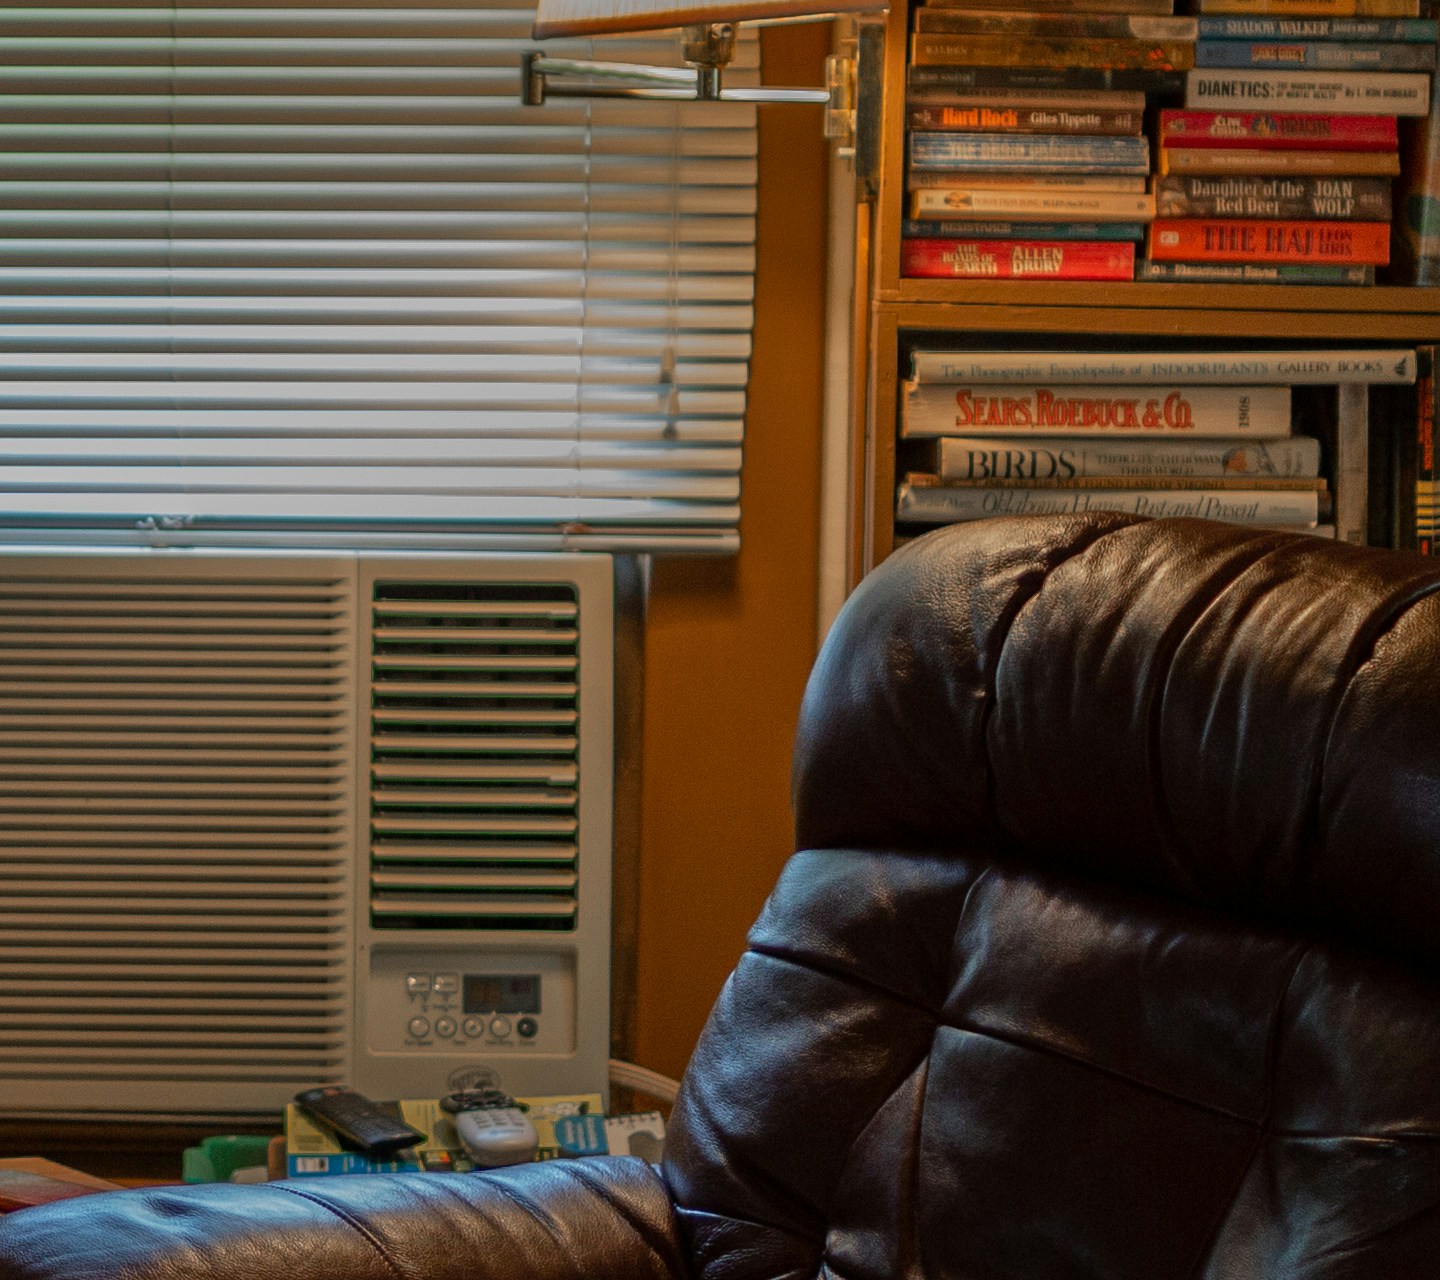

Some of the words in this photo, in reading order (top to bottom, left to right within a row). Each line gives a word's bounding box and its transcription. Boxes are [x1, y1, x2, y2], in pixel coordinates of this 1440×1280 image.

[1197, 80, 1275, 99] DIANETICS:
[943, 109, 977, 126] Hard
[981, 109, 1018, 126] Rock
[1030, 113, 1063, 127] Giles
[1066, 114, 1100, 127] Tippette
[1192, 182, 1257, 198] Daughter
[1260, 182, 1276, 198] of
[1280, 183, 1304, 197] the
[1313, 180, 1353, 198] JOAN
[1216, 197, 1245, 215] Red
[1248, 198, 1280, 216] Deer
[1313, 200, 1355, 216] WOLF
[1204, 226, 1256, 252] THE
[1264, 226, 1313, 253] HAJ
[1012, 247, 1063, 261] ALLEN
[1012, 259, 1063, 273] DRURY
[955, 389, 1032, 428] SEARS,
[1035, 389, 1139, 429] ROEBUCK
[1143, 392, 1163, 429] &
[1163, 392, 1194, 429] CO.
[1239, 395, 1250, 427] 1908
[967, 451, 1076, 480] BIRDS
